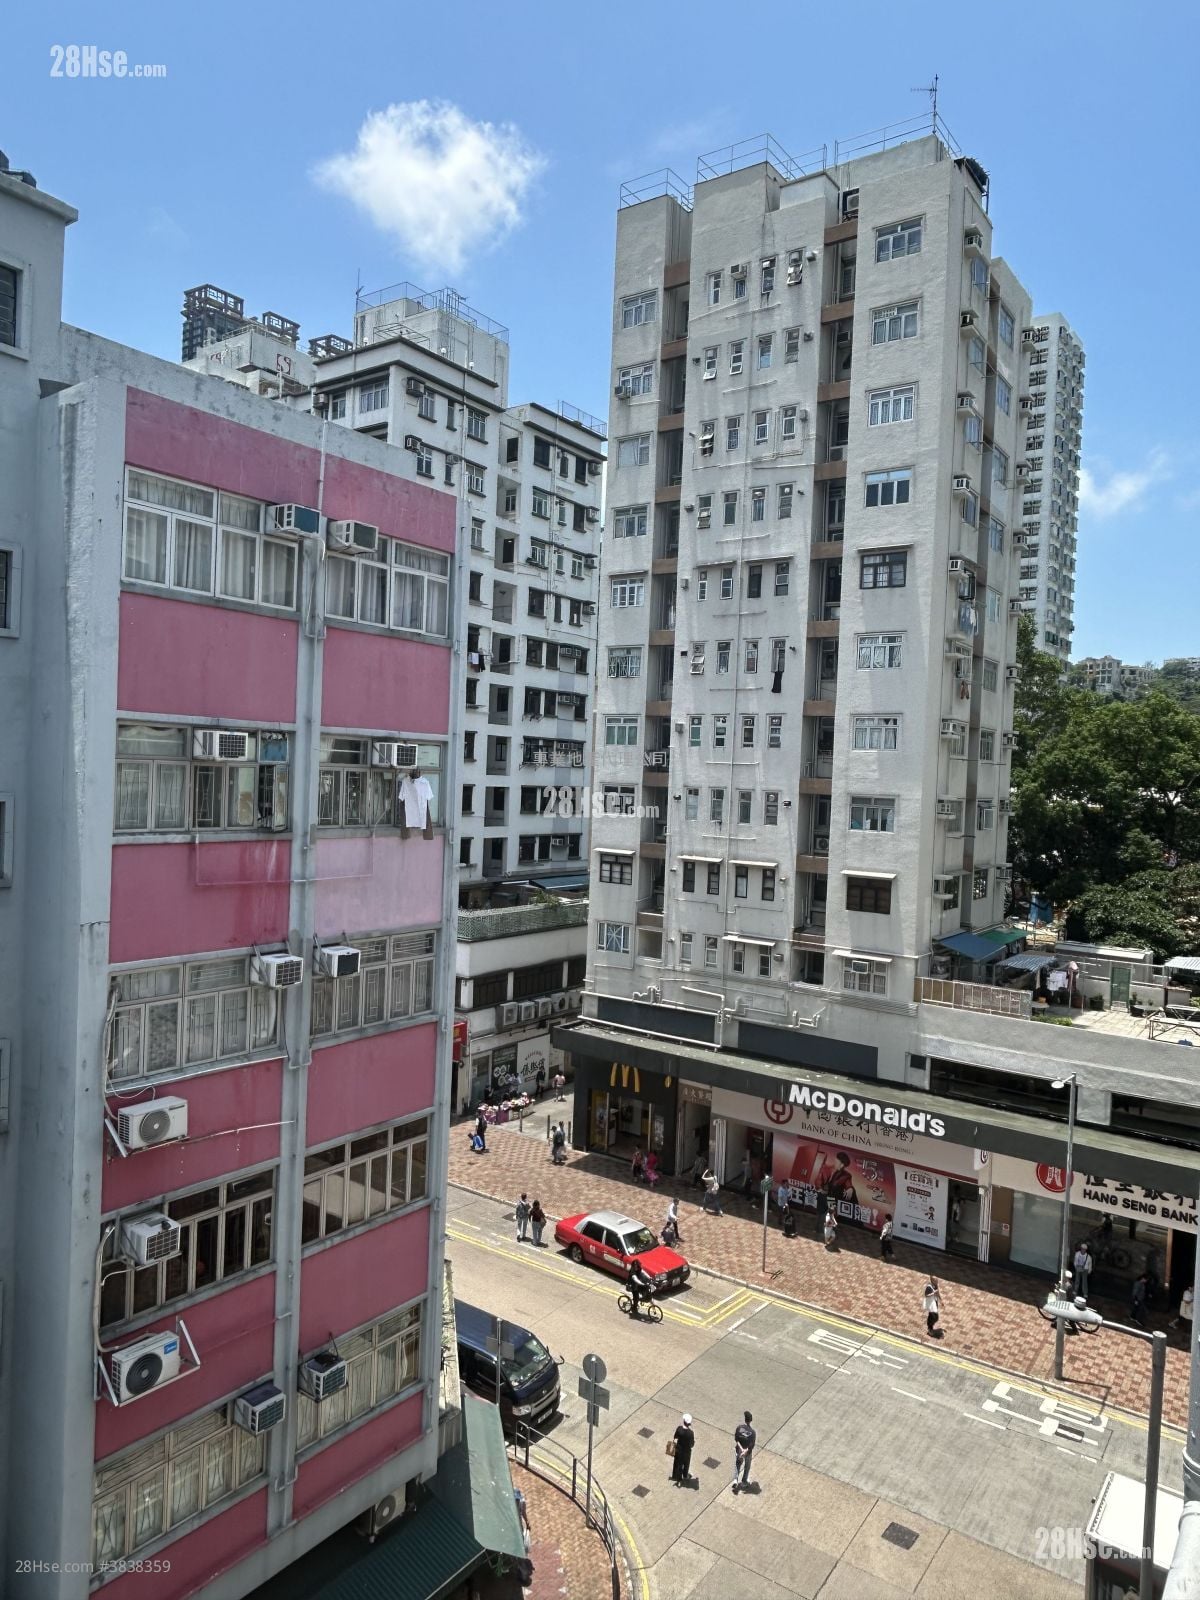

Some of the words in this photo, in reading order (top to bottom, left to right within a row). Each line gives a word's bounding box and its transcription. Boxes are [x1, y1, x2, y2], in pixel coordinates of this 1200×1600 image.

[789, 1084, 946, 1137] McDonald's
[801, 1121, 826, 1134] BANK
[827, 1128, 839, 1138] OF
[841, 1131, 872, 1147] CHINA
[1083, 1188, 1118, 1206] HANG
[1122, 1198, 1157, 1215] SENG
[1161, 1207, 1199, 1226] BANK
